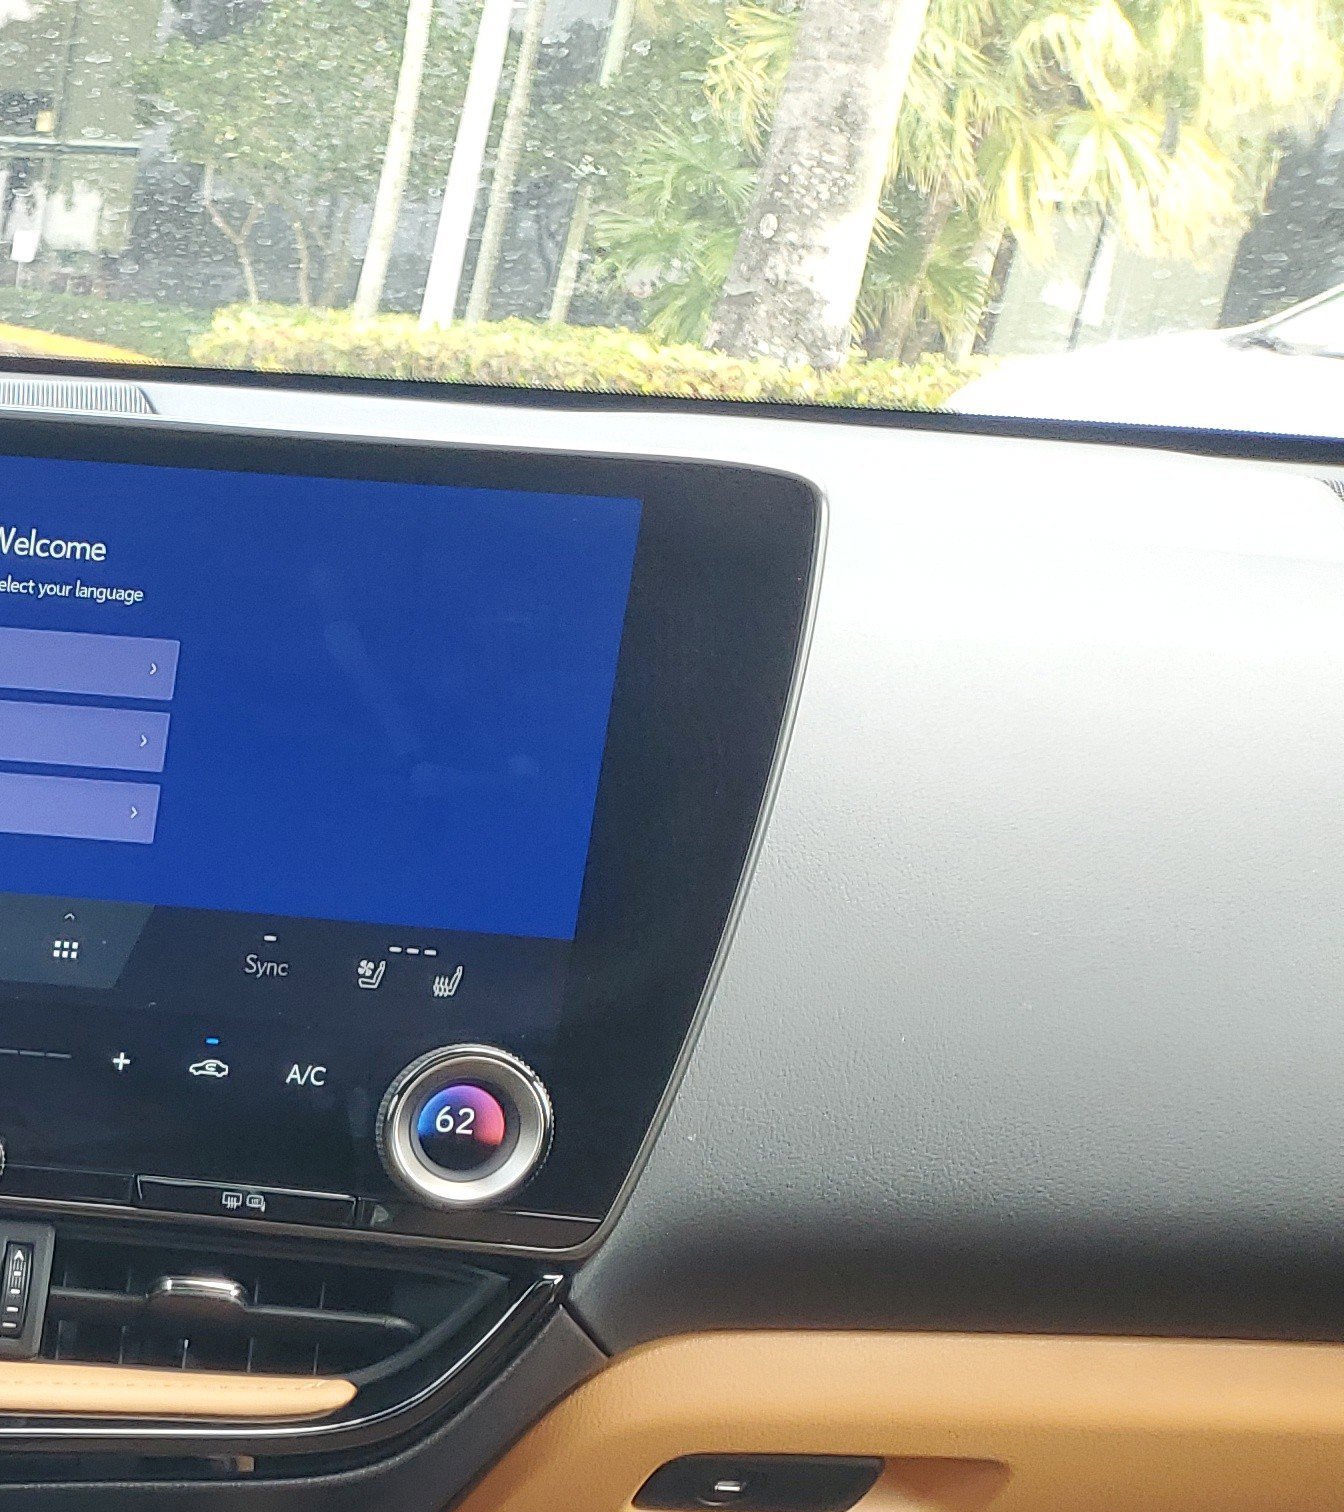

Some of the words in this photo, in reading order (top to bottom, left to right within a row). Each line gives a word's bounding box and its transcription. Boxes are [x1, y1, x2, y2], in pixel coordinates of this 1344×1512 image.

[38, 580, 72, 599] your
[75, 580, 144, 605] language
[244, 954, 289, 978] Sync
[285, 1062, 327, 1088] A/C
[435, 1106, 476, 1137] 62
